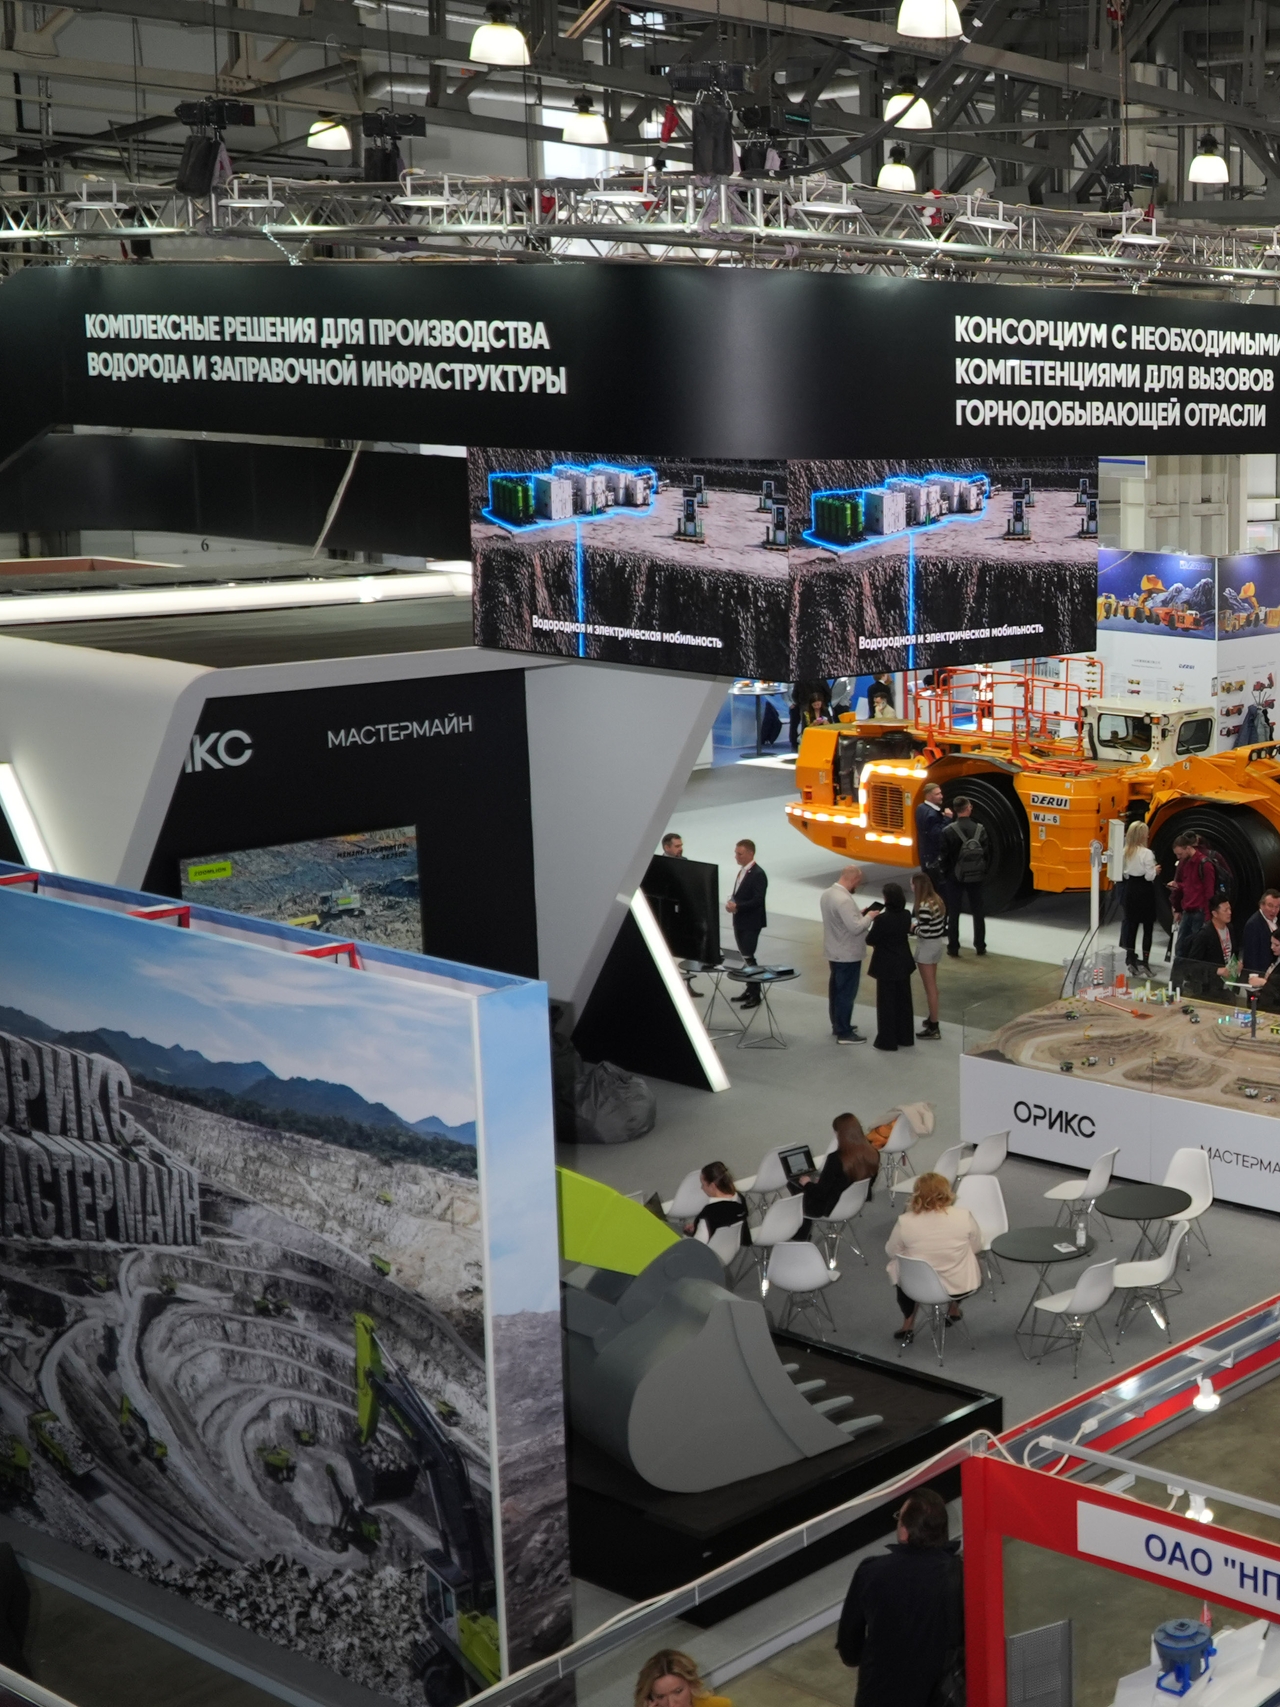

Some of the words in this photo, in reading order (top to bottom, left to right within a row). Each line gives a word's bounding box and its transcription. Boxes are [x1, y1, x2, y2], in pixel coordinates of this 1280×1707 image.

[85, 314, 221, 341] КОМПЛЕКСНЫЕ
[224, 316, 316, 343] РЕШЕНИЯ
[321, 318, 364, 348] ДЛЯ
[369, 319, 550, 352] ПРОИЗВОДСТВА
[955, 315, 1107, 351] КОНСОРЦИУМ
[1111, 324, 1127, 348] С
[87, 352, 190, 383] ВОДОРОДА
[193, 355, 207, 380] И
[210, 354, 357, 385] ЗАПРАВОЧНОЙ
[362, 360, 566, 394] ИНФРАСТРУКТУРЫ
[955, 357, 1140, 391] КОМПЕТЕНЦИЯМИ
[1144, 364, 1183, 392] ДЛЯ
[1188, 366, 1274, 392] ВЫЗОВОВ
[955, 397, 1180, 430] ГОРНОДОБЫВАЮЩЕЙ
[1184, 403, 1266, 427] ОТРАСЛИ
[201, 538, 209, 552] 6
[532, 615, 585, 633] Водородная
[587, 623, 593, 633] и
[594, 624, 661, 642] электрическая
[662, 631, 722, 649] мобильность
[859, 635, 916, 650] Водородная
[917, 635, 924, 644] и
[925, 628, 990, 644] электрическая
[991, 623, 1044, 637] мобильность
[327, 713, 473, 748] МАСТЕРМАЙН
[1031, 795, 1068, 807] DERUI
[0, 1033, 135, 1144] РИКС
[1013, 1100, 1096, 1138] ОРИКС
[1144, 1533, 1213, 1577] ОАО
